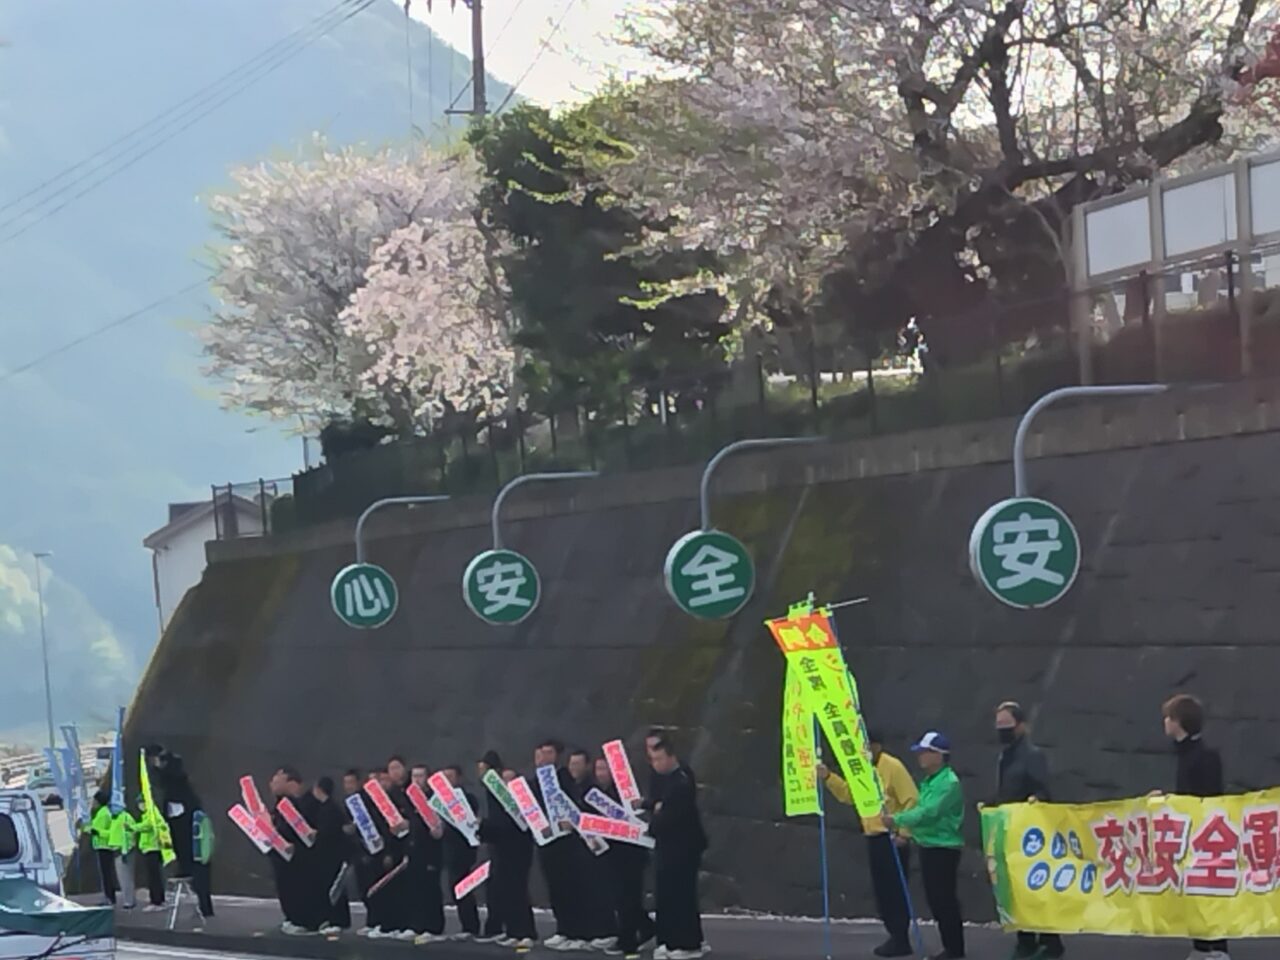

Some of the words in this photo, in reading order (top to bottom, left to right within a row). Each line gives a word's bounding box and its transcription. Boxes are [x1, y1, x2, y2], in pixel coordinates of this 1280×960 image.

[681, 544, 745, 607] 全
[993, 512, 1064, 590] 安
[344, 574, 390, 617] 心
[476, 561, 531, 616] 安
